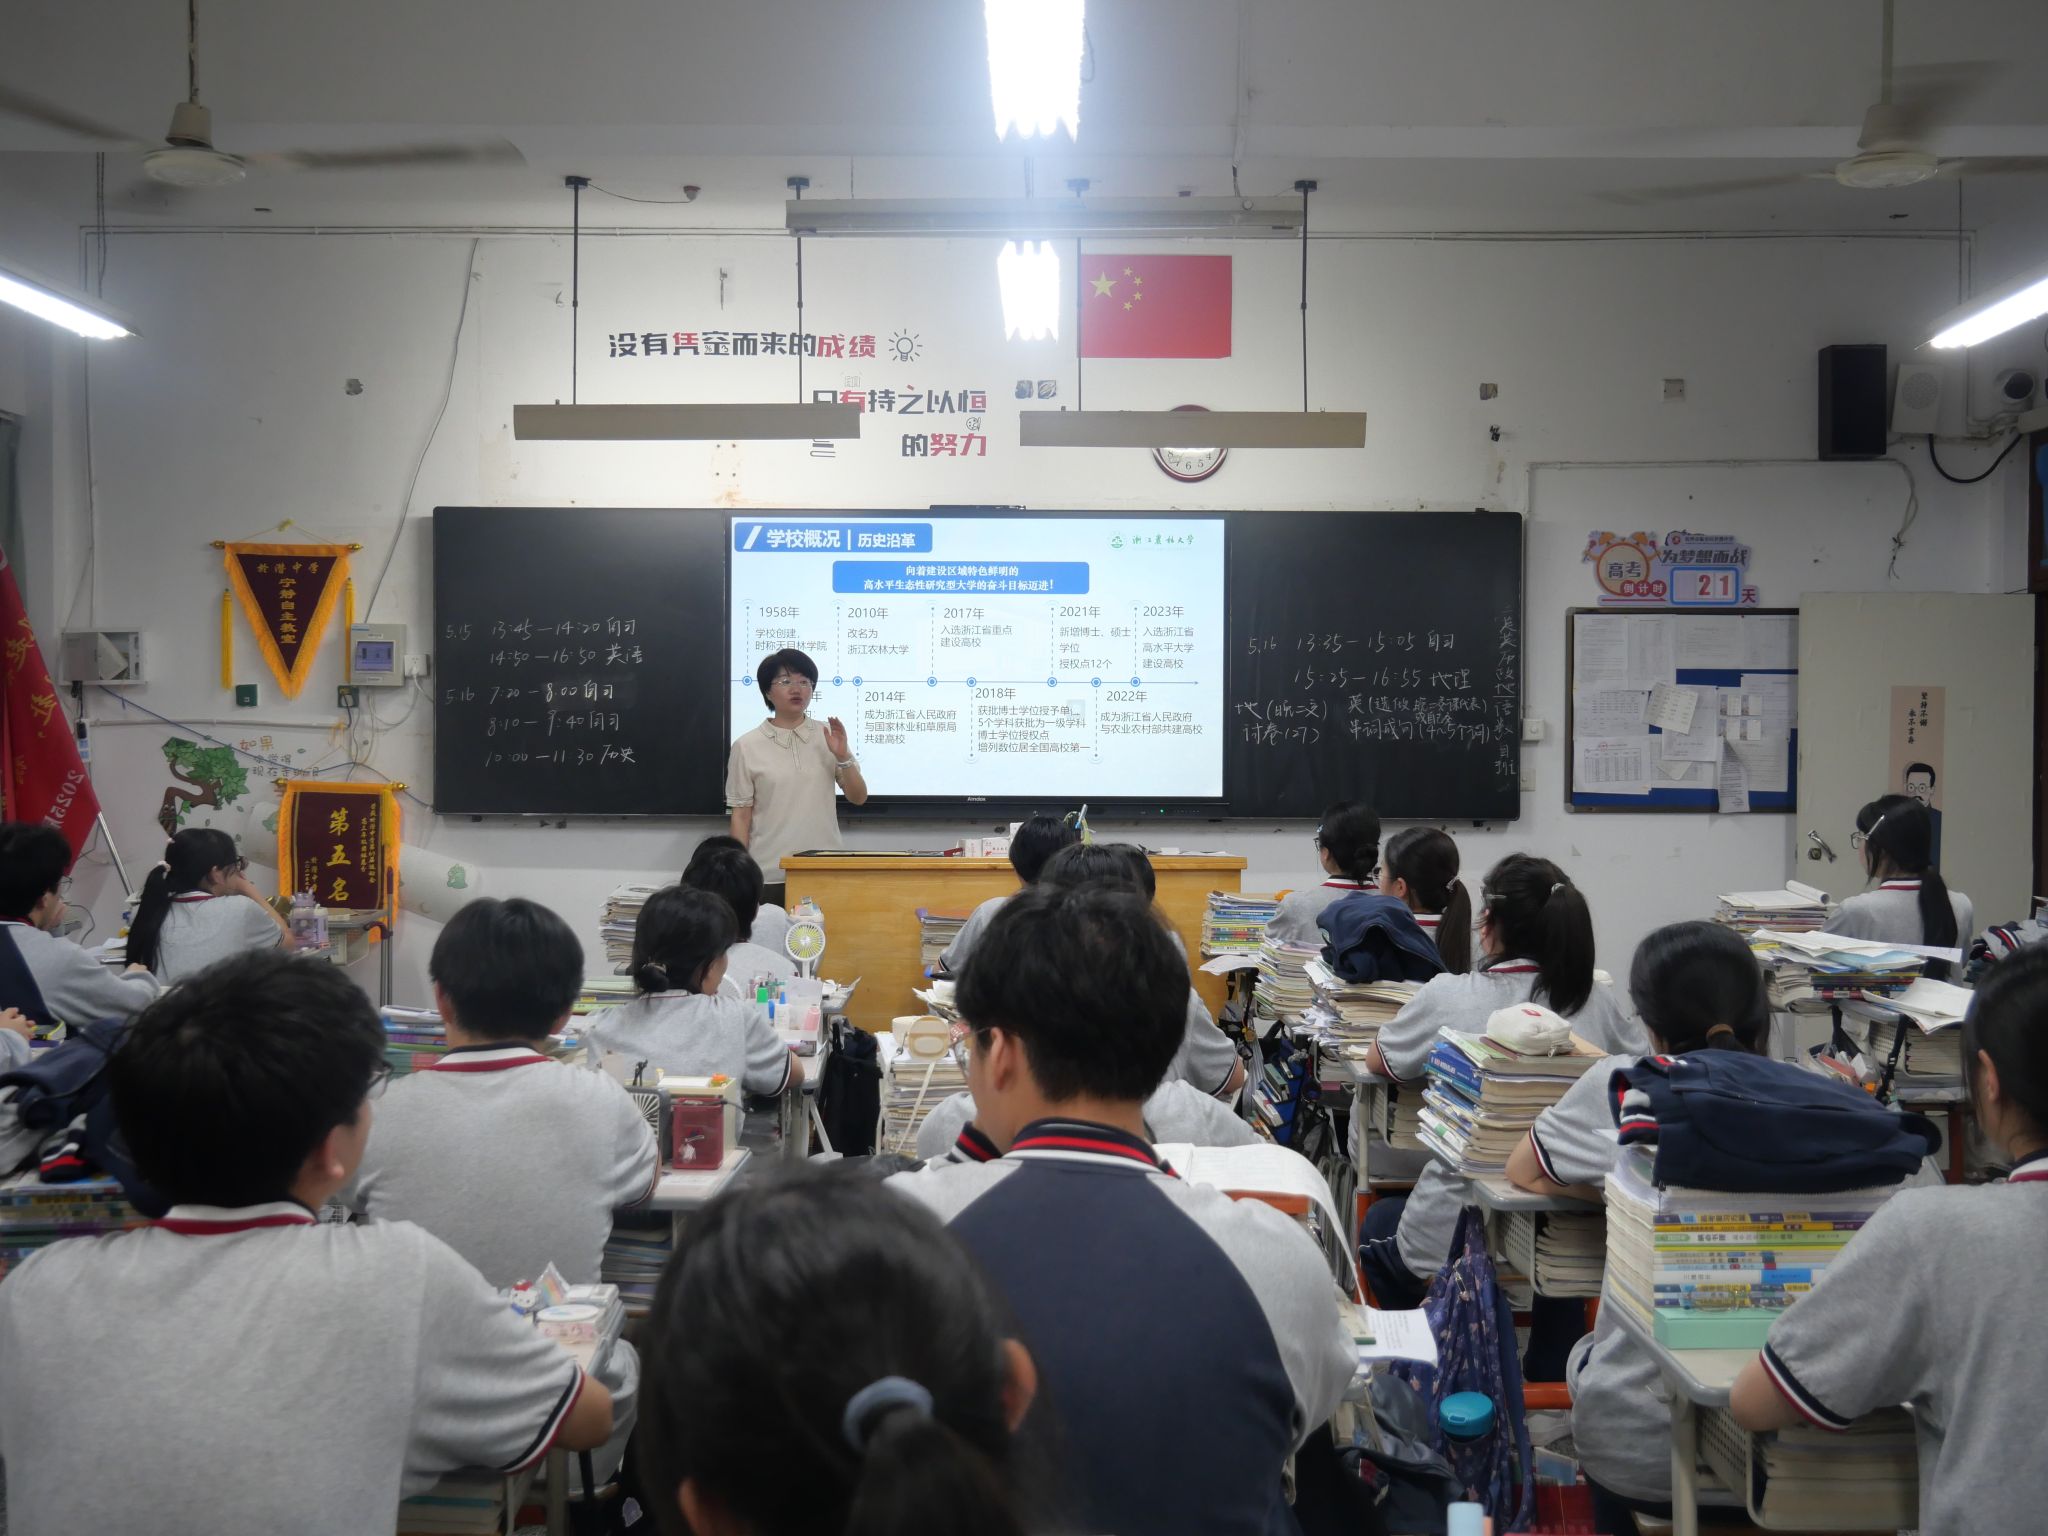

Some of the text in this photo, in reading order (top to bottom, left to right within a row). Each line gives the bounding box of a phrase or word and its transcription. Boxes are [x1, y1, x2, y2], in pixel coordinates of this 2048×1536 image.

[609, 332, 876, 358] 没有凭空而来的成绩
[902, 433, 987, 457] 的努力
[766, 529, 916, 549] 学校概况 历史沿革
[905, 565, 1019, 577] 向着建设区域特色鲜明的
[1608, 561, 1641, 579] 高考
[1623, 583, 1665, 594] 倒计时
[1699, 575, 1729, 596] 21
[1741, 588, 1756, 604] 天
[759, 607, 800, 619] 1958年
[847, 607, 889, 619] 2010年
[943, 607, 985, 620] 2017年
[1059, 606, 1100, 618] 2021年
[1143, 606, 1184, 618] 2023年
[847, 628, 878, 639] 改名为
[940, 625, 1012, 636] 入选浙江省重点
[1059, 627, 1131, 638] 新增博士、硕士
[1143, 627, 1194, 637] 入选浙江省
[940, 637, 981, 648] 建设高校
[1059, 642, 1080, 653] 学位
[1143, 642, 1194, 653] 高水平大学
[847, 644, 909, 655] 浙江农林大学
[1059, 659, 1112, 669] 授权点12个
[1143, 659, 1183, 669] 建设高校
[865, 691, 906, 702] 2014年
[975, 687, 1016, 700] 2018年
[1106, 690, 1148, 702] 2022年
[864, 709, 957, 720] 成为浙江省人民政府
[1100, 711, 1193, 722] 成为浙江省人民政府
[864, 721, 957, 733] 与国家林业和草原局
[978, 717, 1087, 729] 5个学科获批为一级学科
[1100, 724, 1203, 735] 与农业农村部共建高校
[864, 734, 906, 745] 共建高校
[978, 730, 1050, 741] 博士学位授权点
[978, 742, 1091, 753] 增列数位居全国高校第一
[326, 807, 352, 901] 第五名
